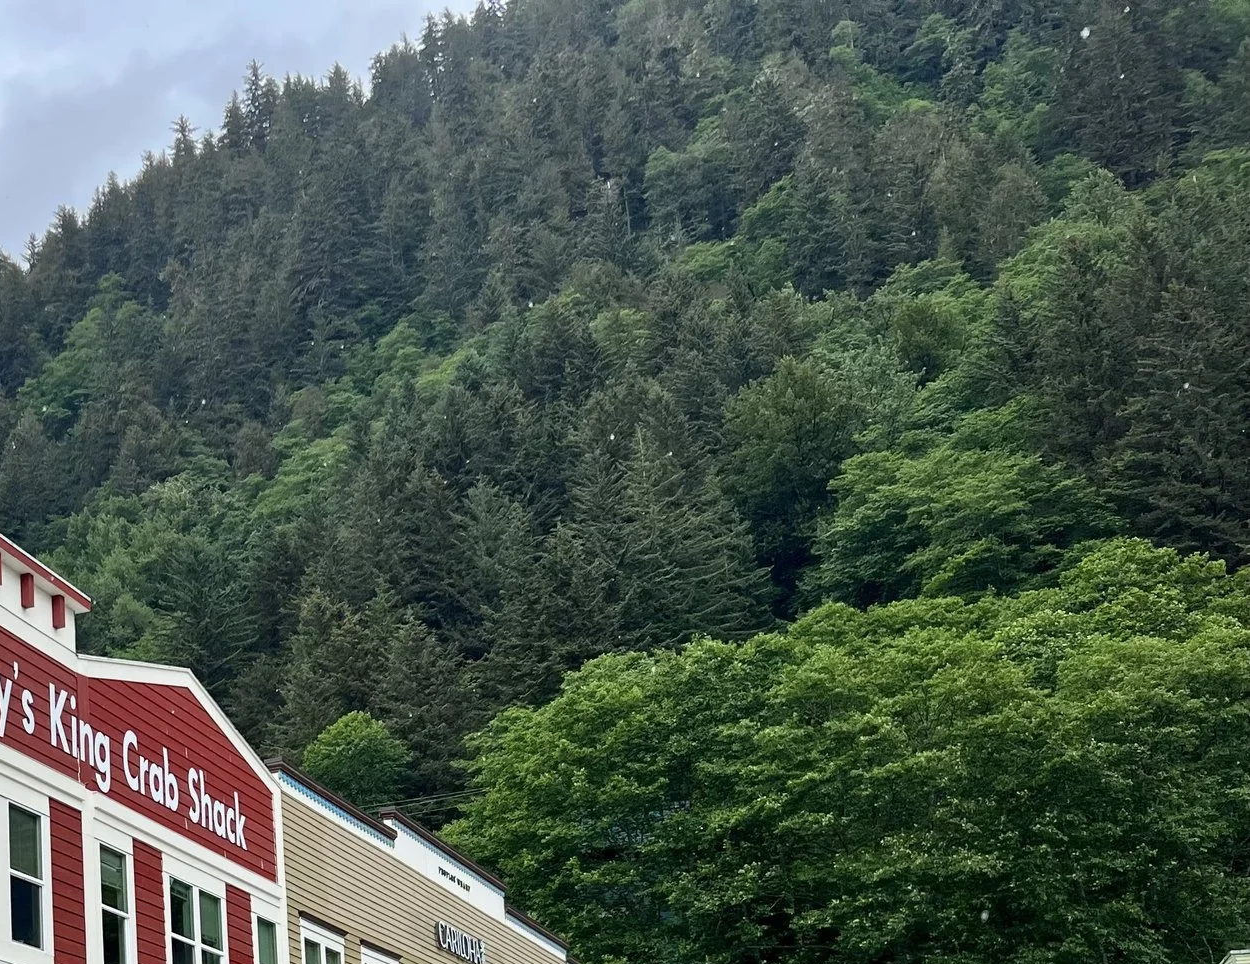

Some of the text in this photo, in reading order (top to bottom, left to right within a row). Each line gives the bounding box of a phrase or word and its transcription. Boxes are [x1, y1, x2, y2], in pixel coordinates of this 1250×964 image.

[49, 683, 110, 793] King
[123, 730, 179, 812] Crab
[188, 767, 248, 851] Shack
